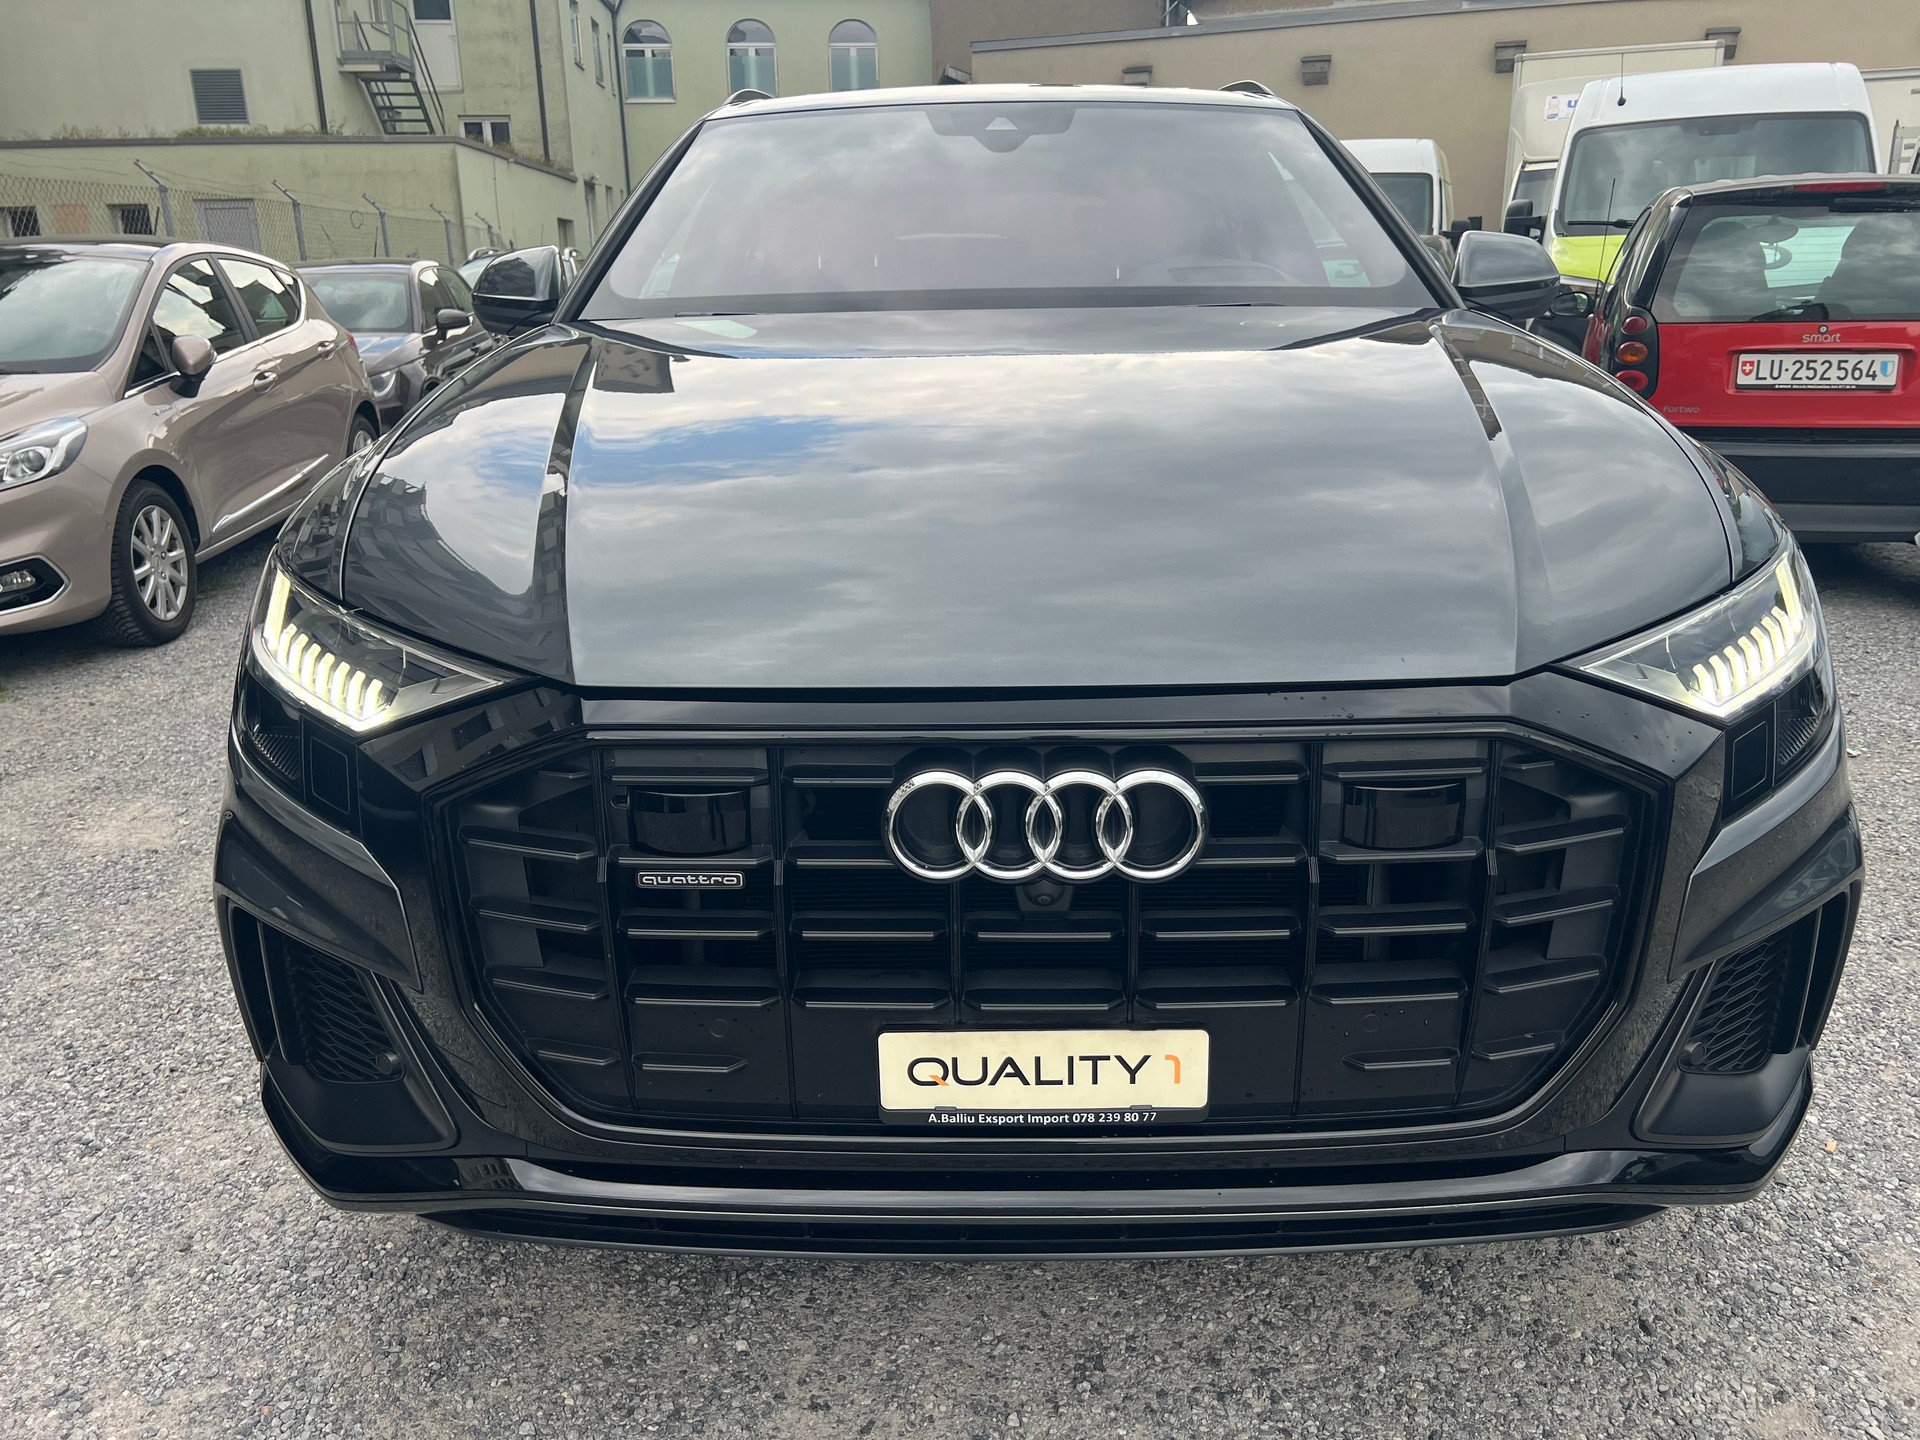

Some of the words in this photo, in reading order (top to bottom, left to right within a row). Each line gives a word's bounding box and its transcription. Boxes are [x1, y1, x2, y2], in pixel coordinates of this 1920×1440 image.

[1802, 333, 1841, 343] smart
[642, 875, 738, 886] quattro
[907, 1054, 1152, 1087] QUALITY
[928, 1113, 975, 1123] A.Balliu
[978, 1113, 1024, 1125] Exsport
[1027, 1113, 1070, 1125] Import
[1072, 1113, 1096, 1123] 078
[1098, 1112, 1121, 1123] 239
[1123, 1112, 1139, 1123] 80
[1142, 1112, 1157, 1122] 77
